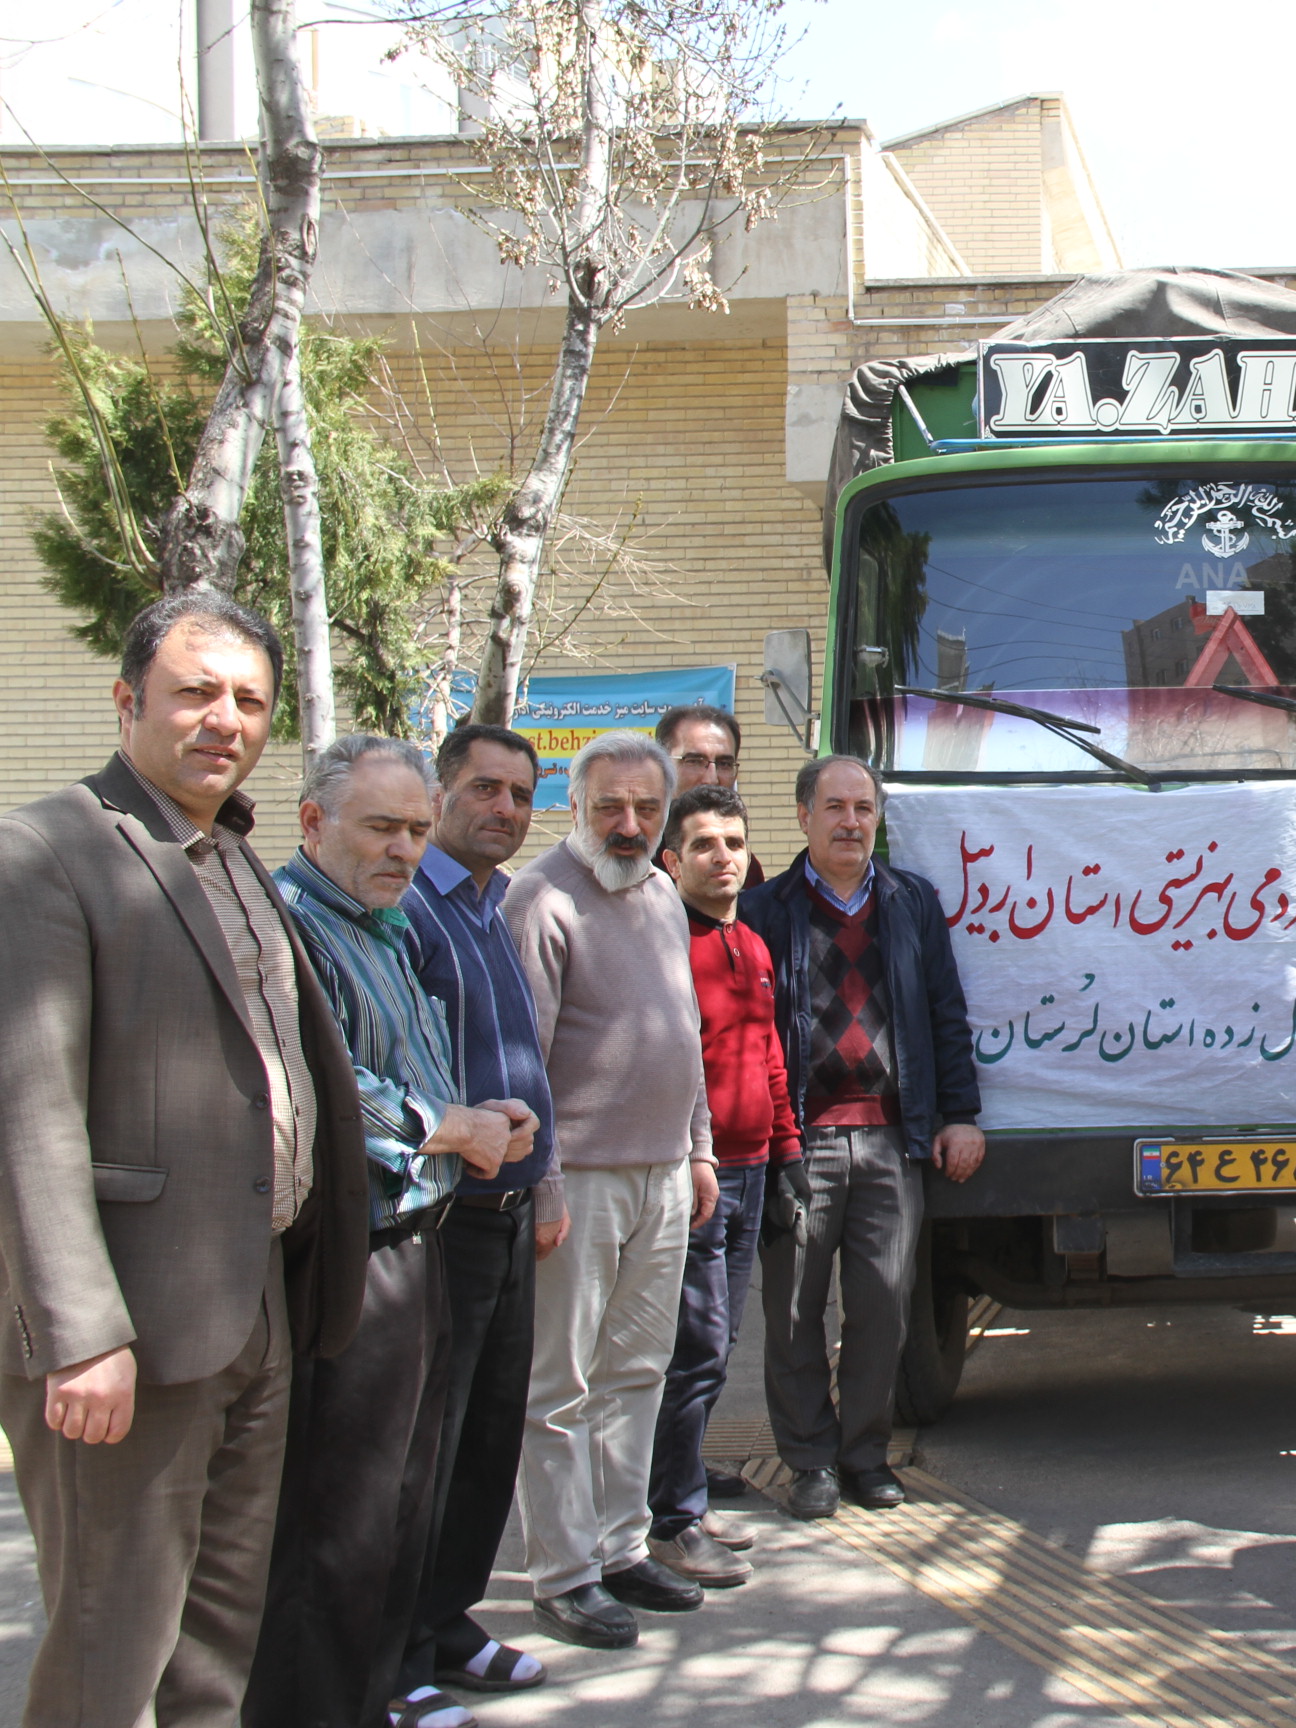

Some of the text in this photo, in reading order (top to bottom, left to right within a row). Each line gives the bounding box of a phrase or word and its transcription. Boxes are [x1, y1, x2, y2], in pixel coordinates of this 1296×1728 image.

[1175, 561, 1253, 590] ANA
[532, 700, 581, 721] الکترونیکی
[582, 701, 612, 717] خدمت
[614, 703, 629, 720] میز
[630, 699, 657, 718] سایت
[935, 831, 1034, 944] اردبیل
[1008, 862, 1122, 941] استان
[1129, 839, 1235, 952] بهزیستی
[1098, 996, 1196, 1064] استان
[1202, 1001, 1257, 1051] زده
